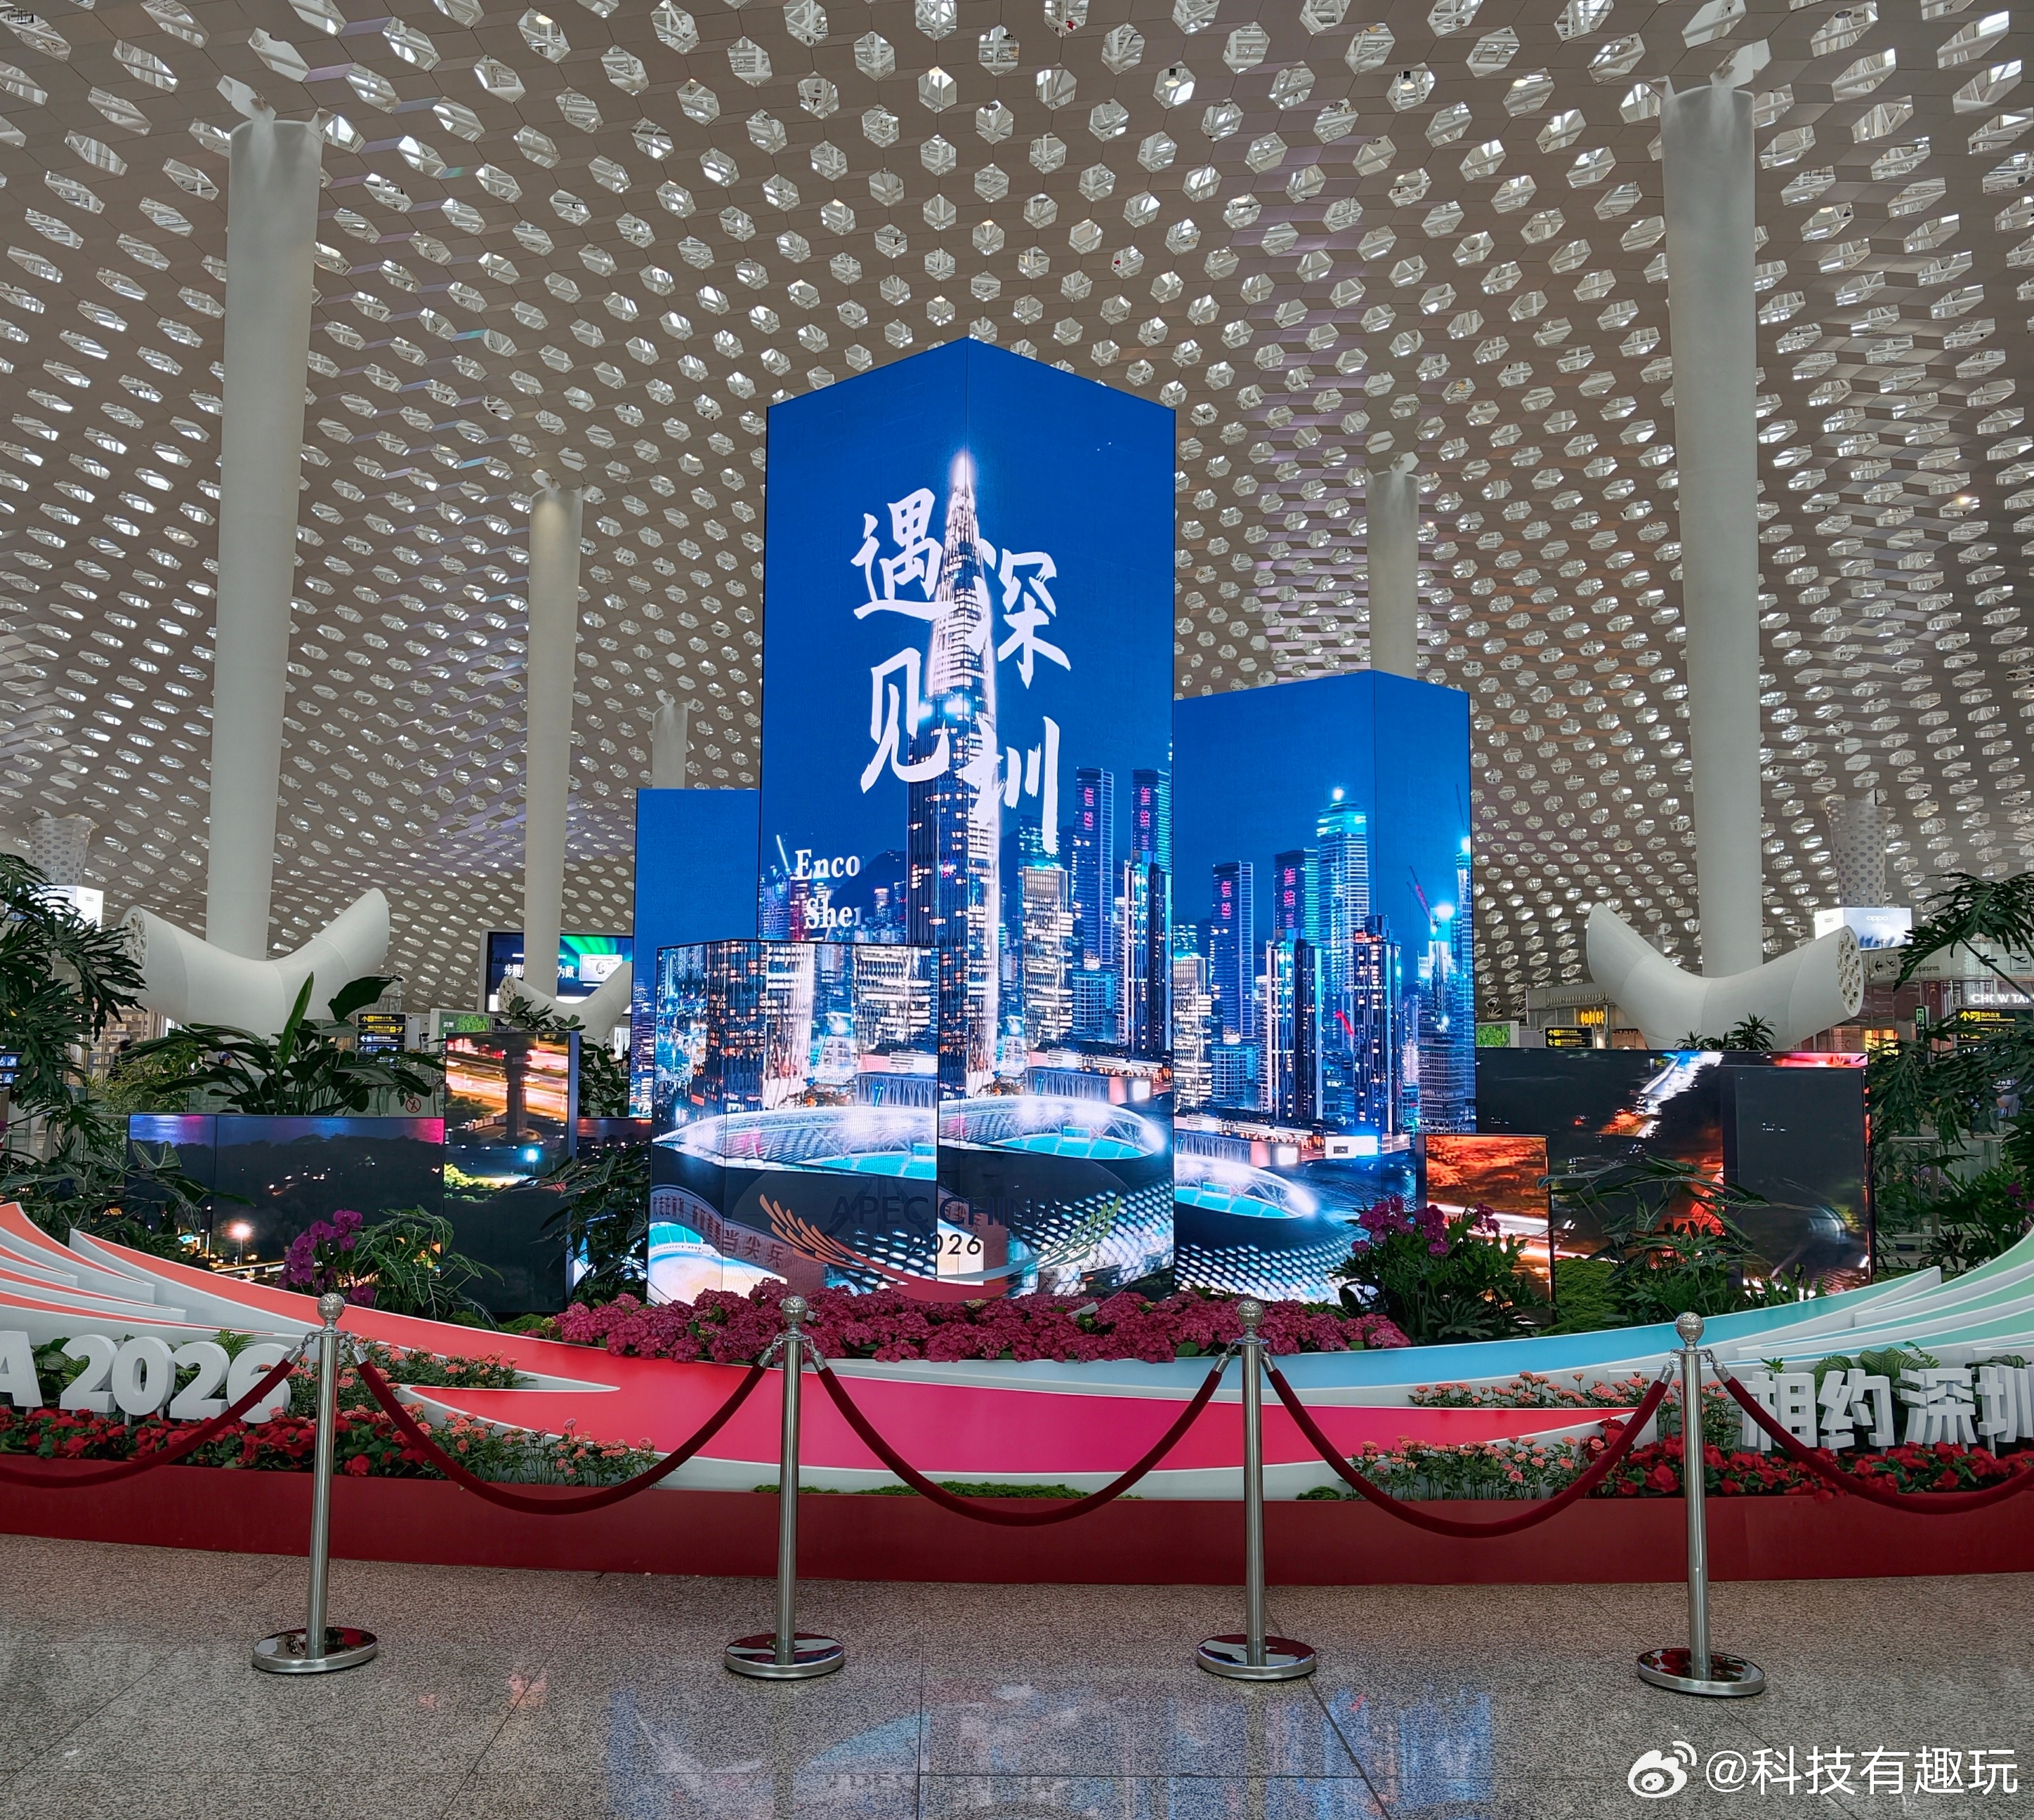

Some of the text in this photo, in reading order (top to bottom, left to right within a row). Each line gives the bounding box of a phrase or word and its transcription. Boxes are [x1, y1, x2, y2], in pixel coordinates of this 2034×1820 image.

[794, 848, 860, 881] Enco
[828, 1196, 930, 1225] APEC
[939, 1196, 1066, 1227] CHINA
[910, 1234, 982, 1256] 2026
[59, 1333, 291, 1424] 2026
